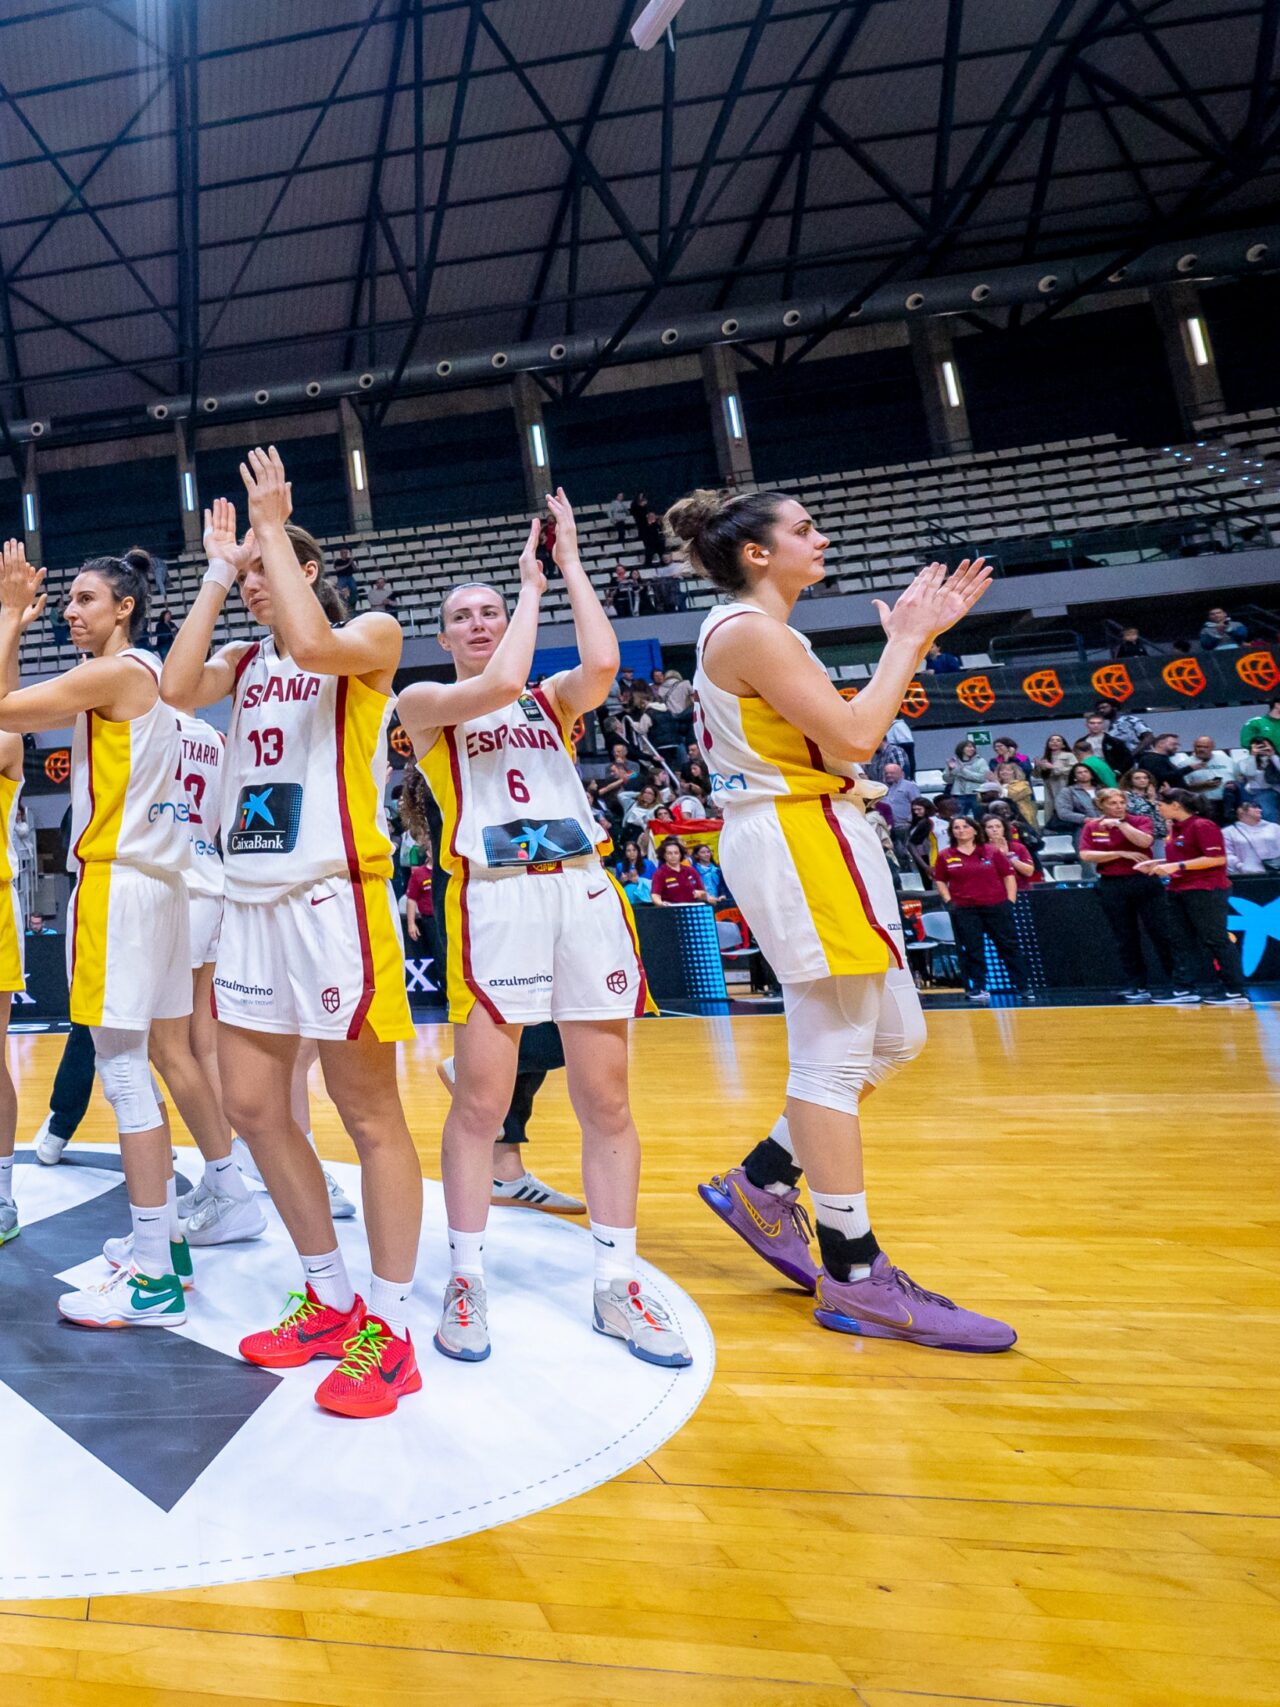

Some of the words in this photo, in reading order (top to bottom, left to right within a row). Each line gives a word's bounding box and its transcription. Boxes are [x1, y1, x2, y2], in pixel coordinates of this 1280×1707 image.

[182, 739, 219, 767] TXARRI
[247, 727, 284, 767] 13
[507, 769, 531, 803] 6
[231, 834, 284, 850] CaixaBank
[215, 977, 273, 996] azulmarino
[489, 973, 553, 987] azulmarino
